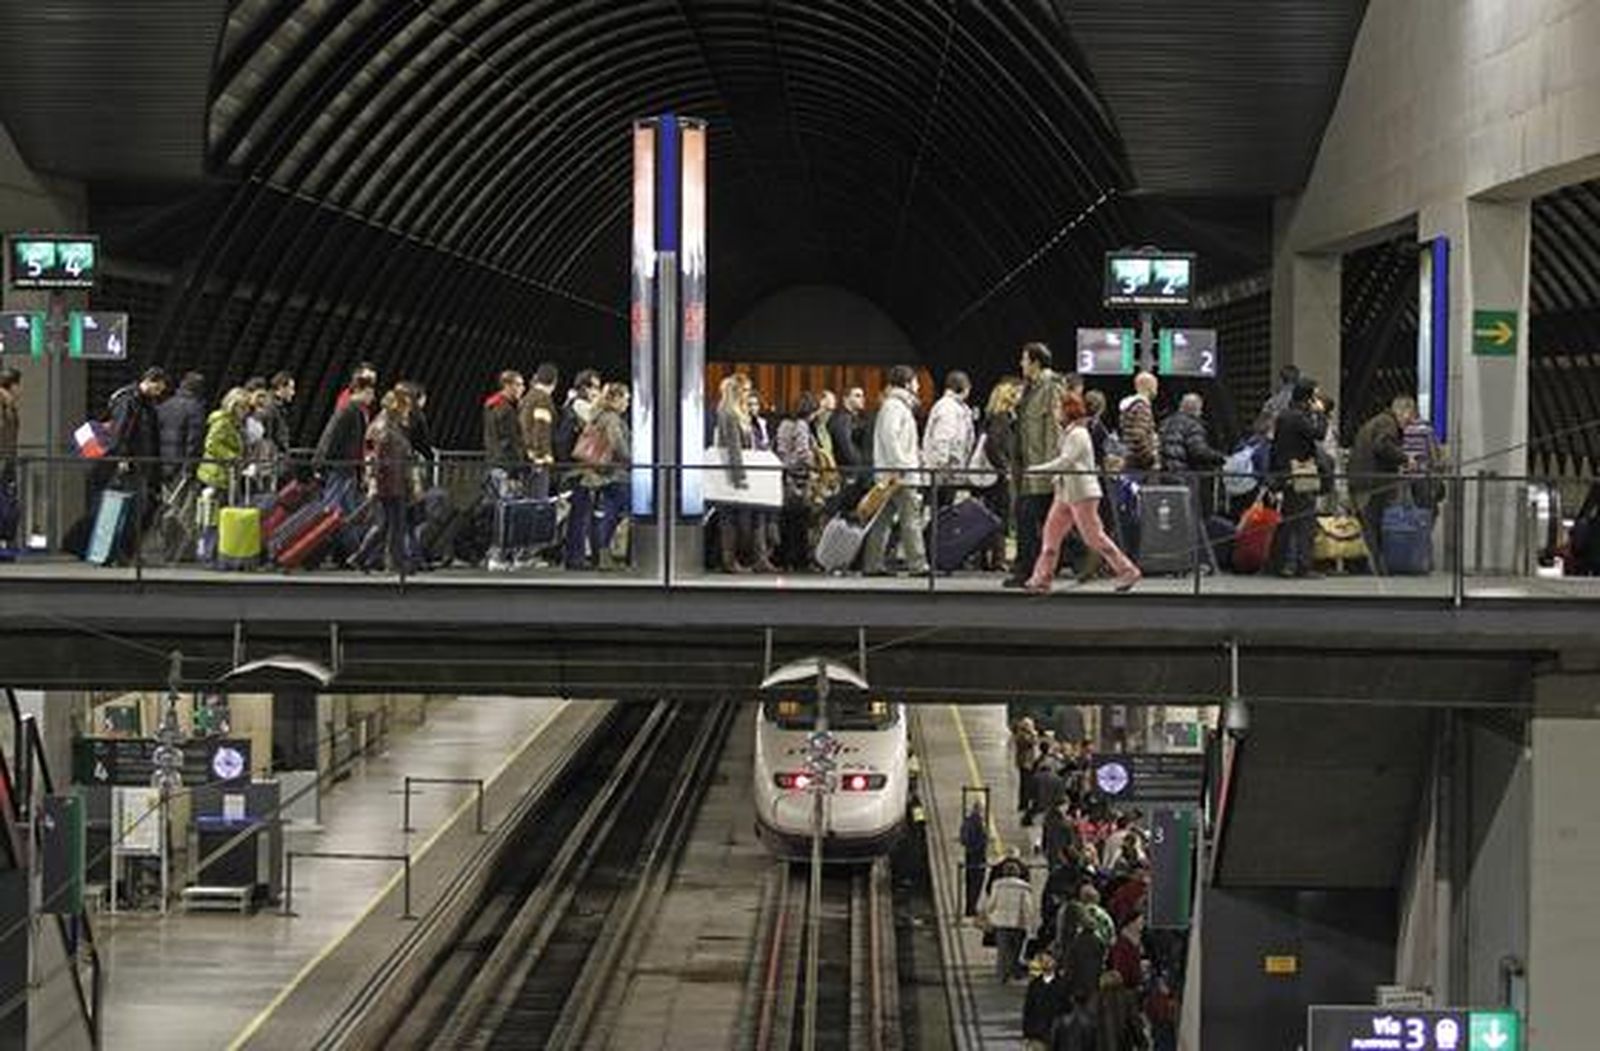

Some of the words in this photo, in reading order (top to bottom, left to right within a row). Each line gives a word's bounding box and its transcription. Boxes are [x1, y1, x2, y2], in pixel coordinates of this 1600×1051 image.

[28, 255, 42, 277] 5
[65, 254, 83, 277] 4
[1122, 277, 1136, 294] 3
[1161, 277, 1175, 295] 2
[107, 334, 121, 355] 4
[1079, 350, 1093, 371] 3
[1200, 351, 1213, 372] 2
[94, 762, 108, 782] 4
[1154, 827, 1164, 844] 3
[1405, 1017, 1424, 1049] 3
